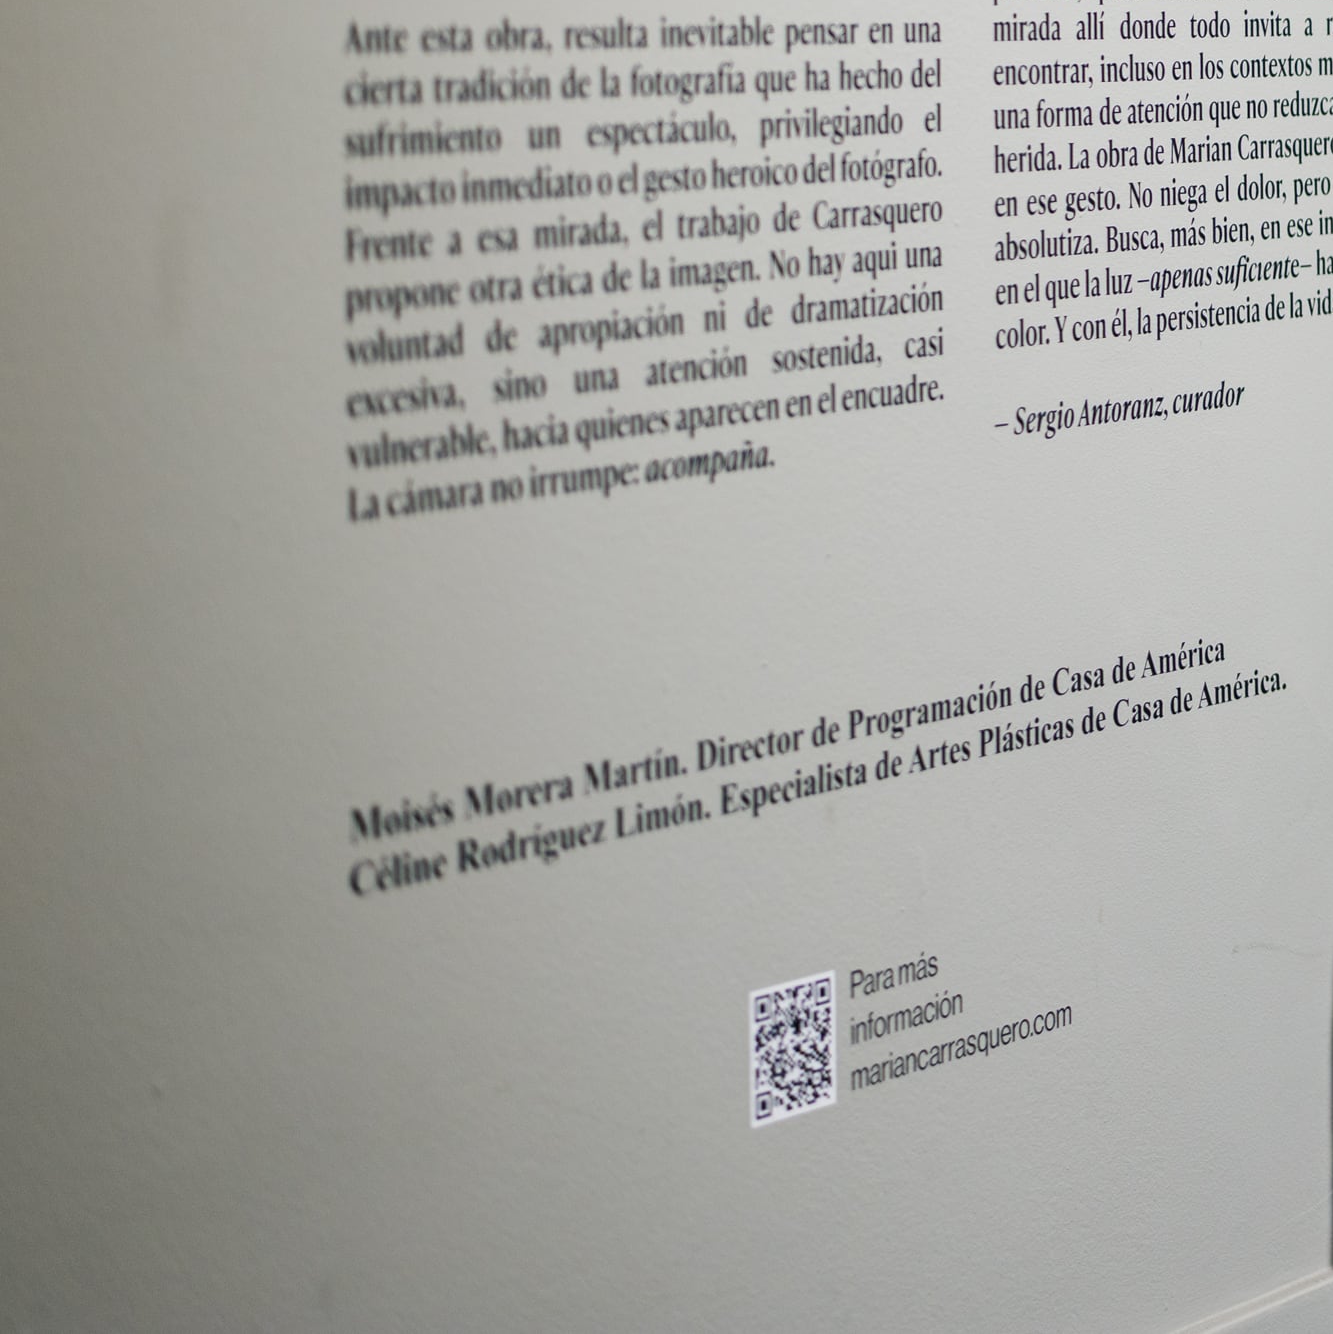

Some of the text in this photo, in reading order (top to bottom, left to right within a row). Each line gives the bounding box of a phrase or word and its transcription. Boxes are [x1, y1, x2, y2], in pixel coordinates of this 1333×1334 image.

[346, 14, 942, 55] Ante esta obra, resulta inevitable pensar en una
[992, 60, 1094, 89] encontrar,
[1099, 53, 1166, 83] incluso
[1171, 60, 1193, 81] en
[1199, 51, 1224, 80] los
[1229, 54, 1313, 79] contextos
[344, 102, 942, 159] sufrimiento un espectáculo, privilegiando el
[994, 142, 1063, 174] herida.
[1068, 142, 1091, 170] La
[1096, 138, 1139, 169] obra
[1143, 136, 1165, 166] de
[1170, 134, 1233, 165] Marian
[994, 227, 1099, 262] absolutiza.
[1105, 225, 1165, 254] Busca,
[1170, 217, 1206, 248] más
[1211, 215, 1255, 247] bien,
[1260, 220, 1281, 241] en
[1286, 217, 1314, 239] ese
[345, 281, 944, 365] voluntad de apropiación ni de dramatización
[345, 326, 944, 420] excesiva, sino una atención sostenida, casi
[1013, 400, 1075, 440] Sergio
[1077, 396, 1169, 428] Antoranz,
[1172, 380, 1246, 415] curador
[350, 638, 1226, 840] Moisés Morera Martín. Director de Programación de Casa de América
[348, 668, 1287, 897] Céline Rodríguez Limón. Especialista de Artes Plásticas de Casa de América.
[849, 951, 939, 999] Para más
[850, 989, 964, 1046] información
[850, 1005, 1072, 1091] mariancarrasquero.com
